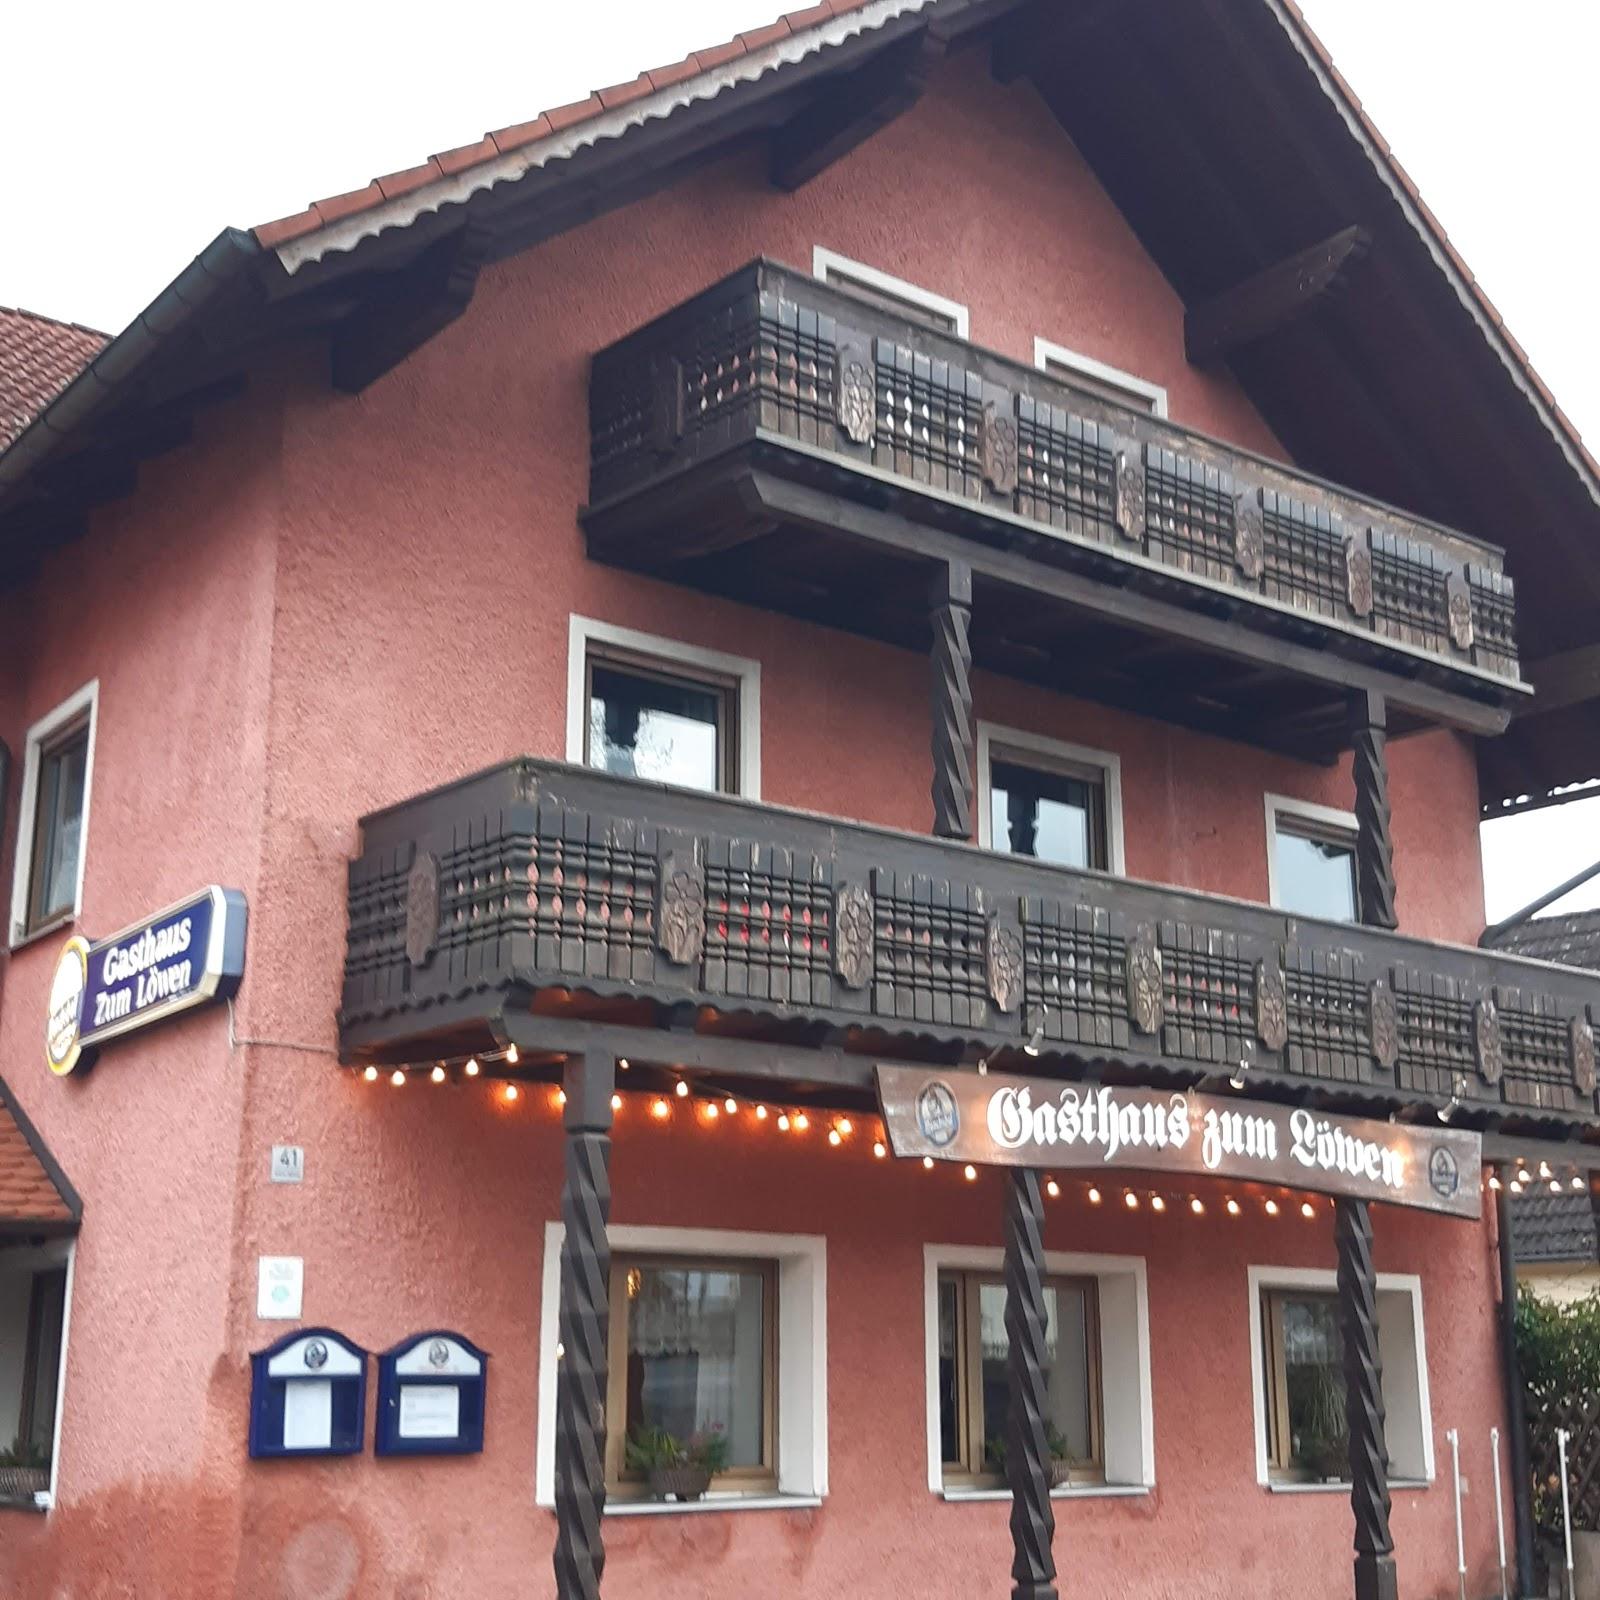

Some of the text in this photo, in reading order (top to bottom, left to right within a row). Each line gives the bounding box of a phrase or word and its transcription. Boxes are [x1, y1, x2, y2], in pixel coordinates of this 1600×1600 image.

[103, 917, 192, 986] Gasthaus
[136, 959, 192, 1009] Löwen
[280, 1148, 297, 1168] 41
[986, 1086, 1404, 1189] Gasthaus zum Löwen
